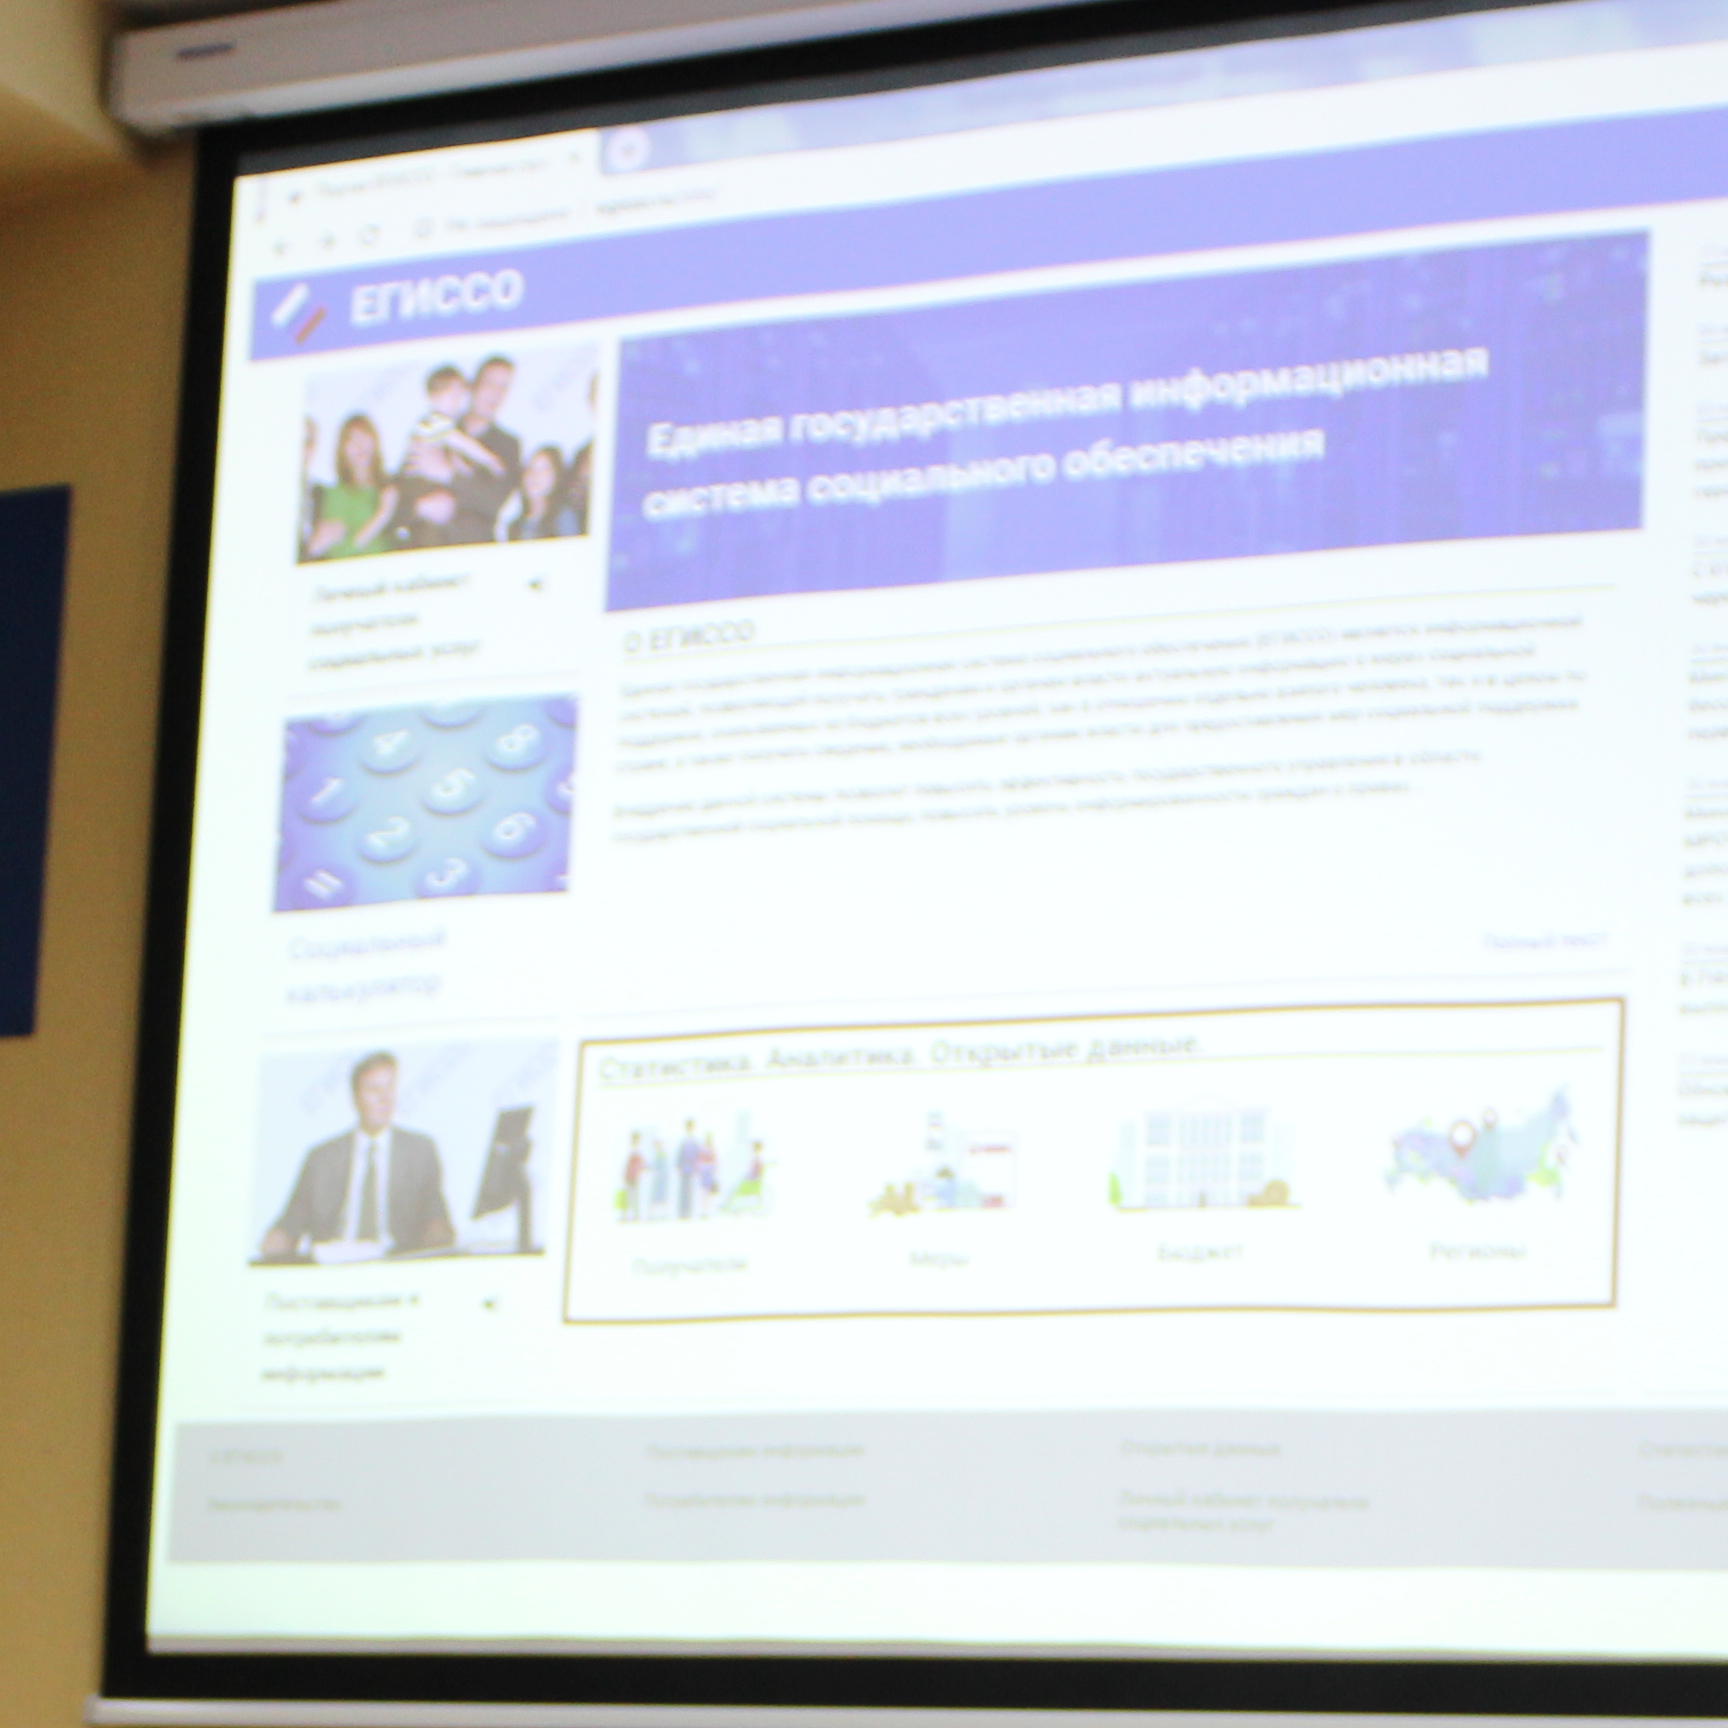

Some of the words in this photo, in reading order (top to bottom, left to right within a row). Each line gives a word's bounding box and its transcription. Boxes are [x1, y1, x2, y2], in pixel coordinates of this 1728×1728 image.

[349, 267, 527, 327] ЕГИССО
[645, 415, 784, 462] Единая
[789, 379, 1121, 455] государственная
[1128, 343, 1491, 418] информационная
[642, 473, 801, 522] система
[806, 450, 1058, 508] социального
[1064, 424, 1327, 487] обеспечения
[623, 630, 643, 656] О
[649, 619, 757, 652] ЕГИССО
[929, 1039, 1078, 1070] Открытые
[1428, 1240, 1529, 1262] Регионы
